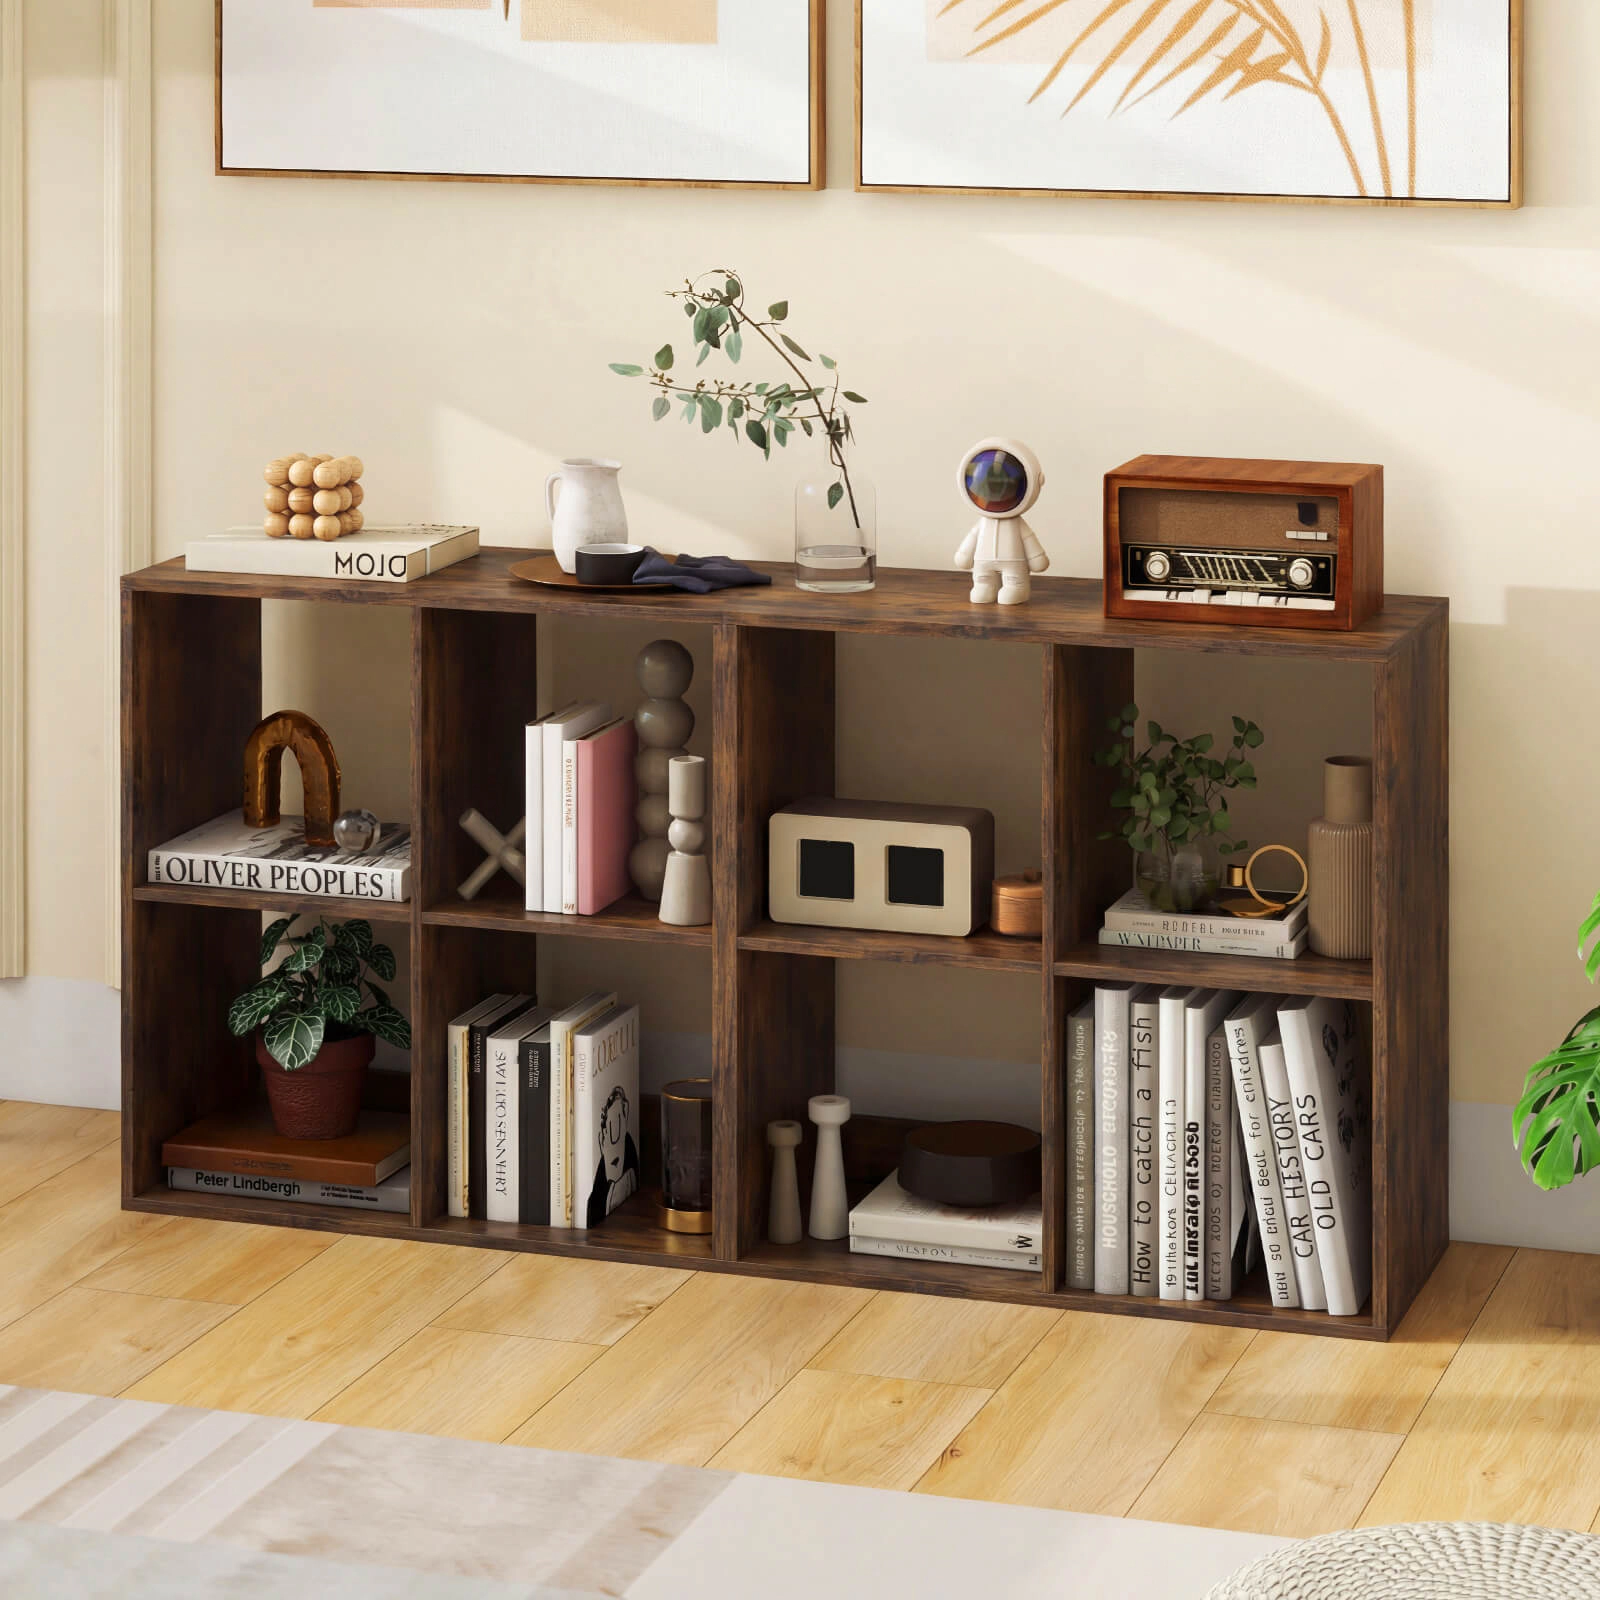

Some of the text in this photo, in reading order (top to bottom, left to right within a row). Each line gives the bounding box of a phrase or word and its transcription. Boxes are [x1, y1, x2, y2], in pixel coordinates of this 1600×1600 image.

[166, 857, 262, 888] OLIVER
[270, 865, 384, 898] PEOPLES
[1249, 1112, 1262, 1139] for
[1132, 1017, 1152, 1284] How to catch a fish
[1269, 1097, 1305, 1200] HISTORY
[1299, 1094, 1336, 1230] OLD CARS
[195, 1171, 229, 1188] Peter
[233, 1175, 301, 1197] Lindbergh
[1295, 1214, 1314, 1258] CAR
